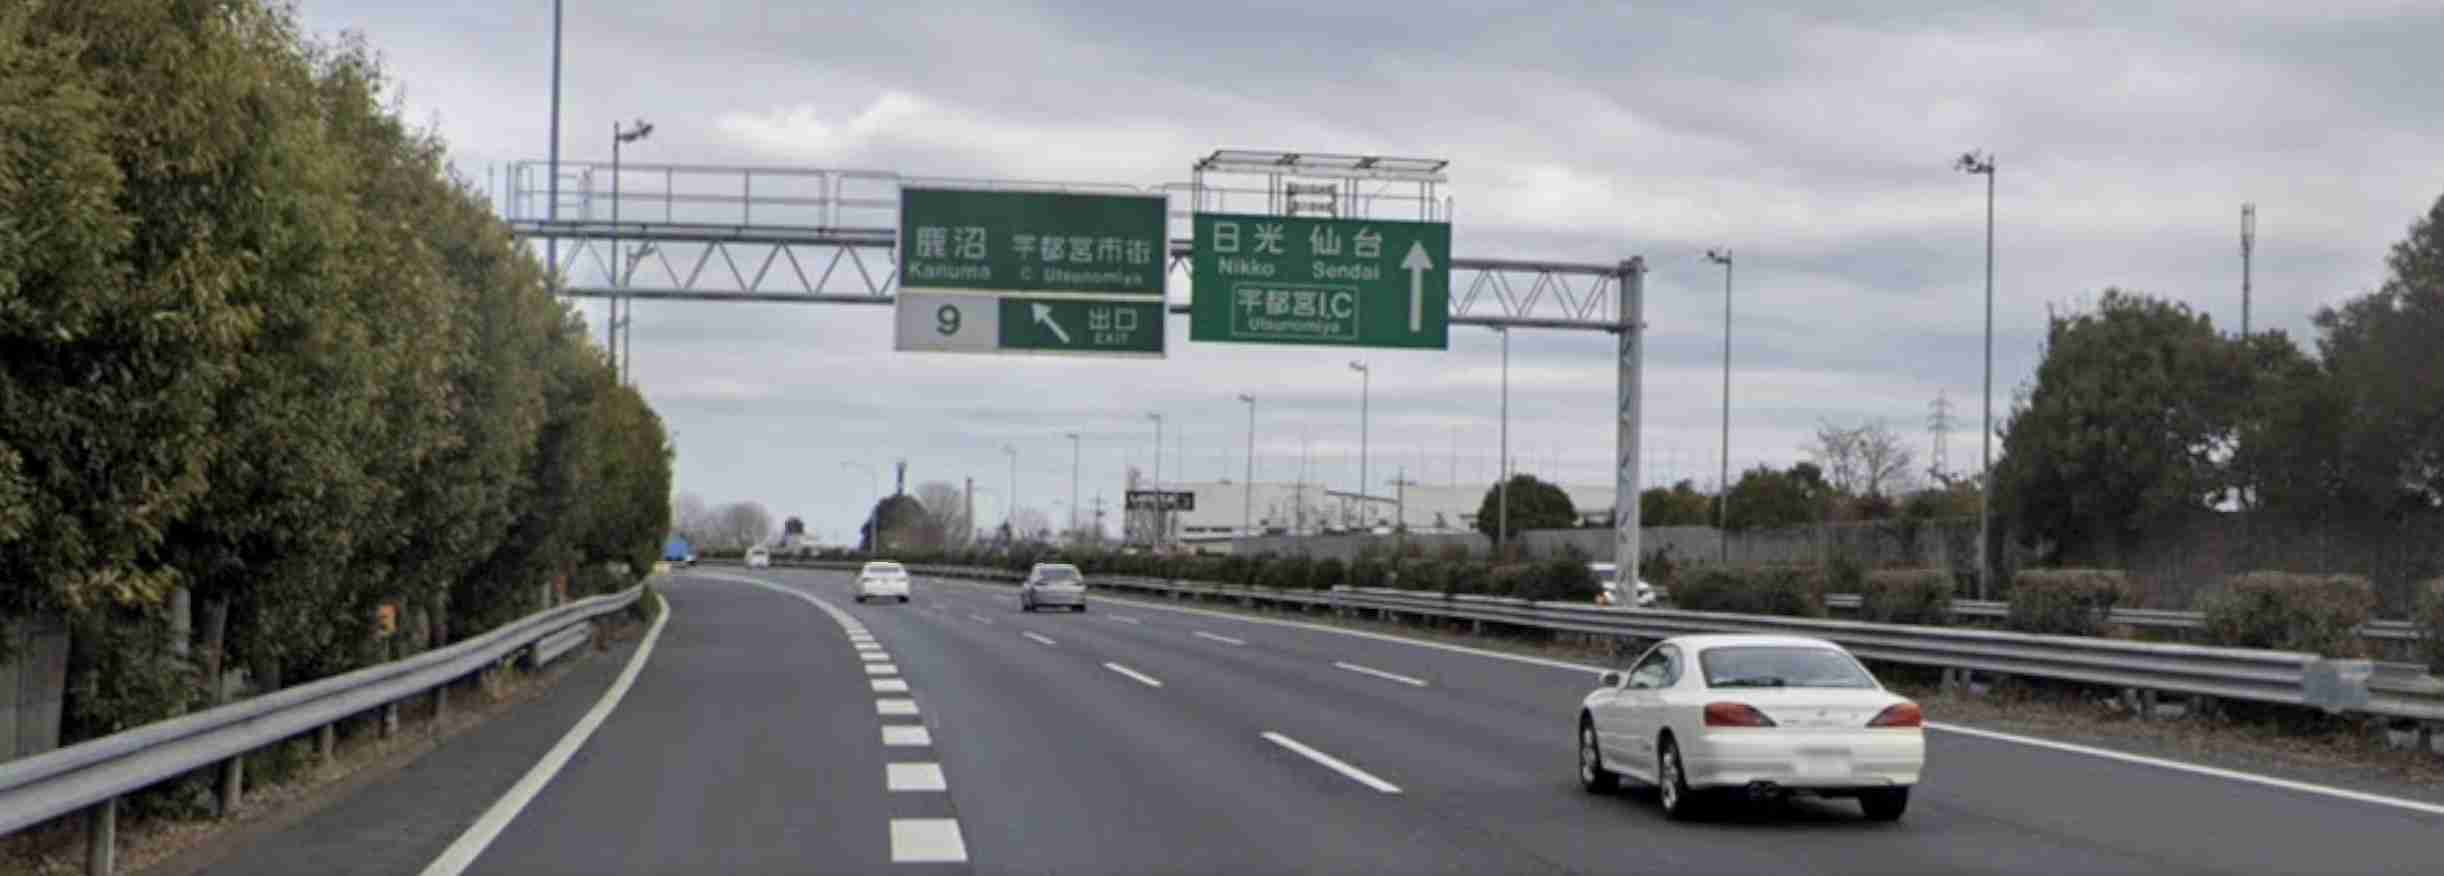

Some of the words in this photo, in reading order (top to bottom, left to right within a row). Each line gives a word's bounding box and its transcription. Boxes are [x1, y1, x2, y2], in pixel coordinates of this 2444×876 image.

[916, 226, 987, 259] 鹿沼
[1012, 234, 1151, 264] 宇都宮市街
[1213, 221, 1284, 254] 日光
[1309, 225, 1383, 258] 仙台
[908, 260, 992, 280] Kanuma
[1044, 267, 1143, 286] Utsunomiya
[1217, 257, 1276, 277] Nikko
[1312, 261, 1380, 280] Sendai
[936, 304, 961, 336] 9
[1088, 307, 1138, 332] 出口
[1248, 318, 1341, 337] Utsunomiya
[1095, 332, 1130, 345] EXIT
